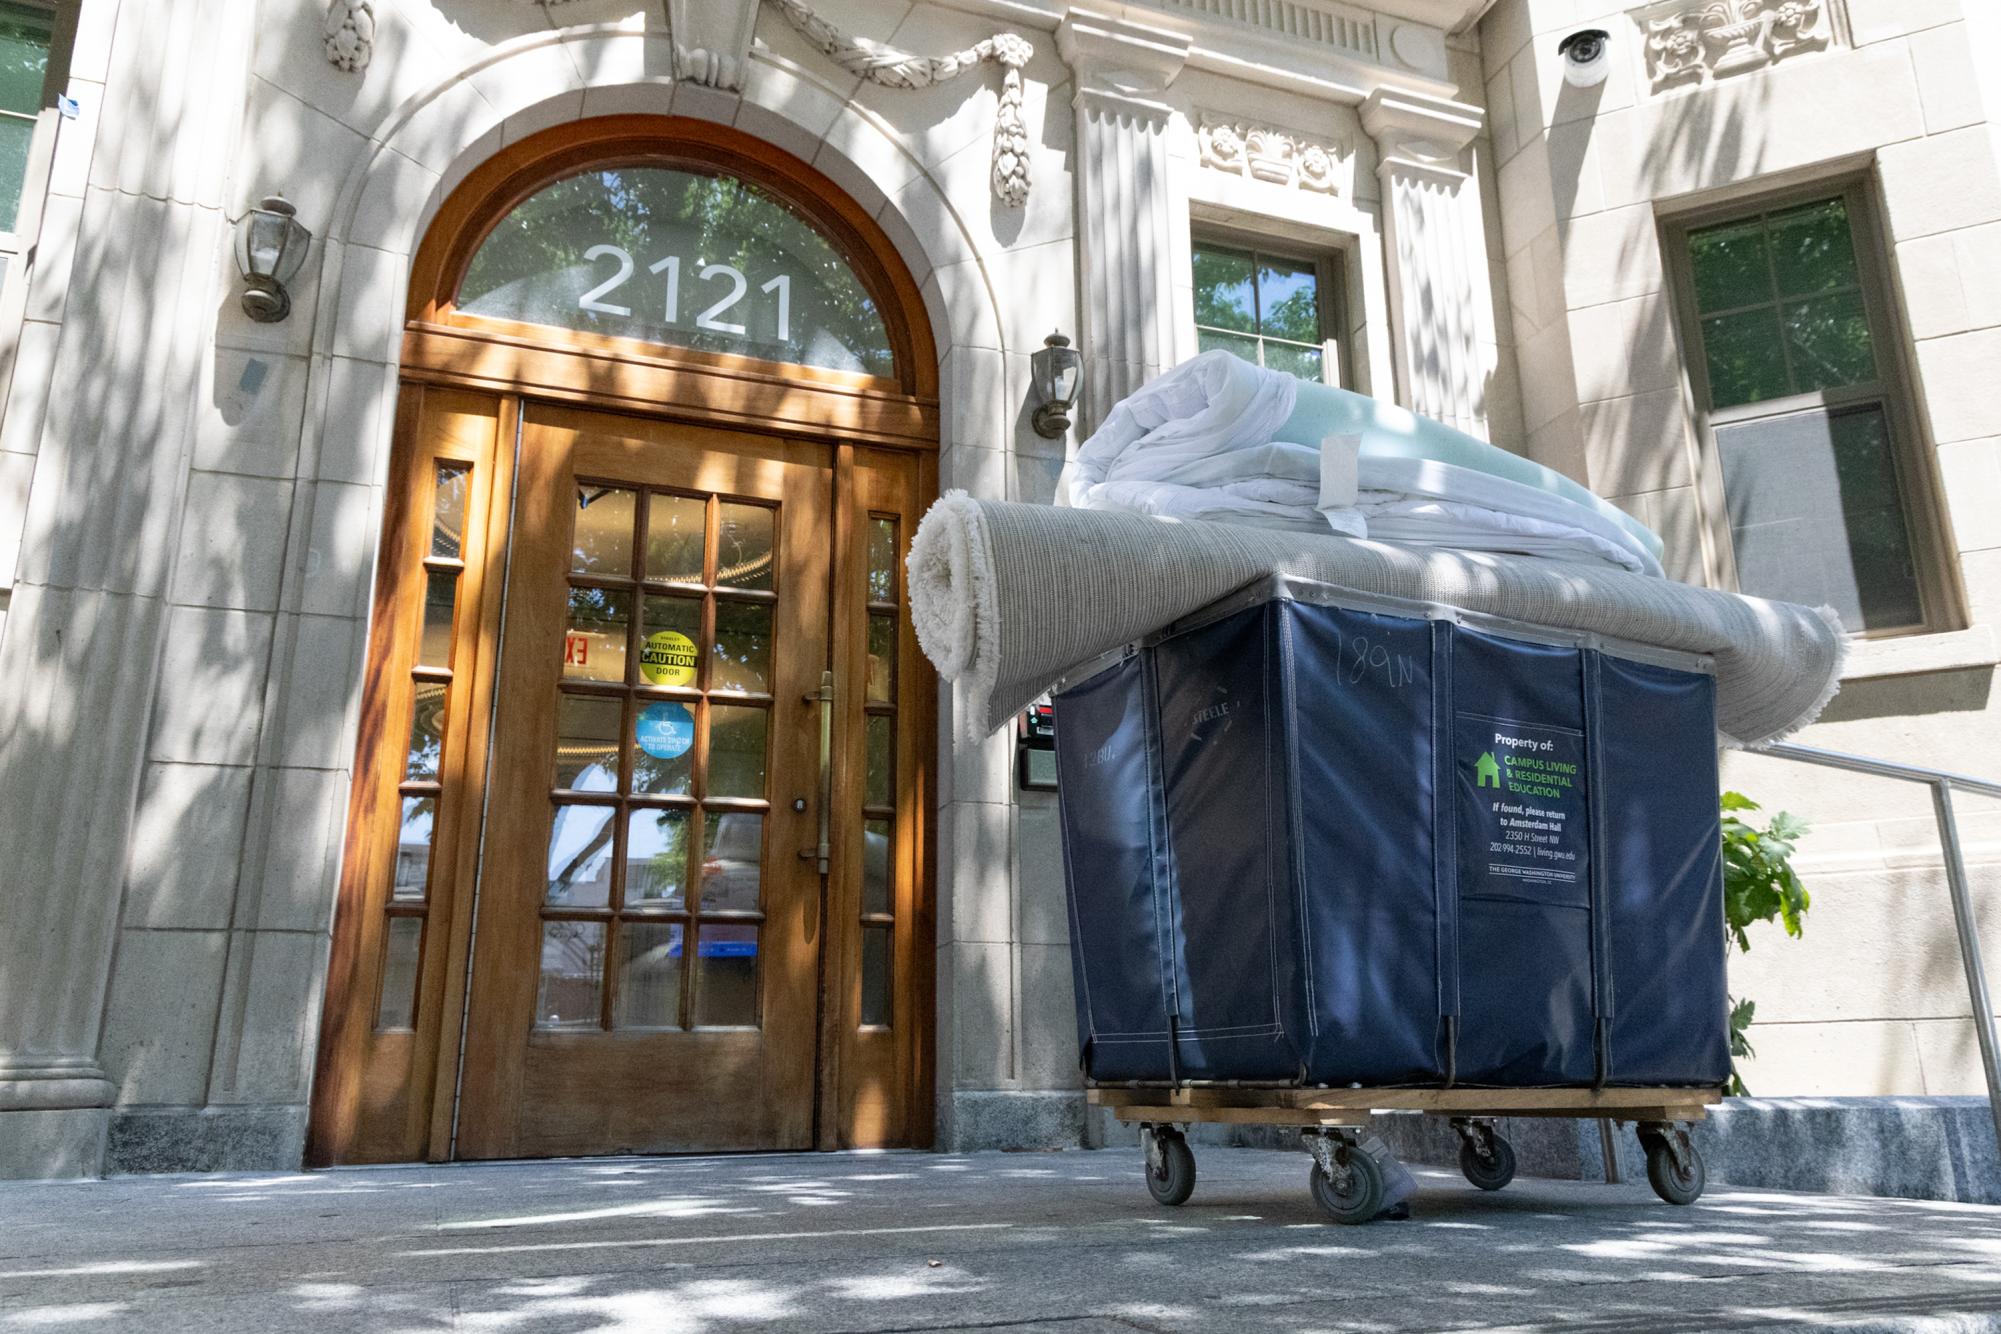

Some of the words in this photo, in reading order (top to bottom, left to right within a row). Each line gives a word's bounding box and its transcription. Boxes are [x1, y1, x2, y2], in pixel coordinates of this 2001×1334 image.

[578, 244, 790, 341] 2121
[644, 641, 695, 653] AUTOMATIC
[641, 653, 695, 666] CAUTION
[656, 667, 680, 676] DOOR
[1191, 702, 1231, 725] STEELE
[1495, 733, 1538, 751] Property
[1540, 740, 1554, 751] of:
[1504, 755, 1544, 770] CAMPUS
[1546, 761, 1577, 775] LIVING
[1506, 769, 1513, 778] &
[1515, 771, 1573, 787] RESIDENTIAL
[1508, 782, 1561, 798] EDUCATION
[1492, 802, 1499, 812] If
[1501, 803, 1525, 816] found,
[1525, 807, 1545, 818] please
[1546, 811, 1566, 820] return
[1500, 818, 1508, 826] to
[1509, 818, 1549, 831] Amsterdam
[1549, 822, 1562, 832] Hall
[1505, 831, 1524, 842] 2350
[1524, 832, 1530, 842] H
[1531, 833, 1549, 843] Street
[1549, 835, 1560, 845] NW
[1501, 867, 1522, 875] GEORGE
